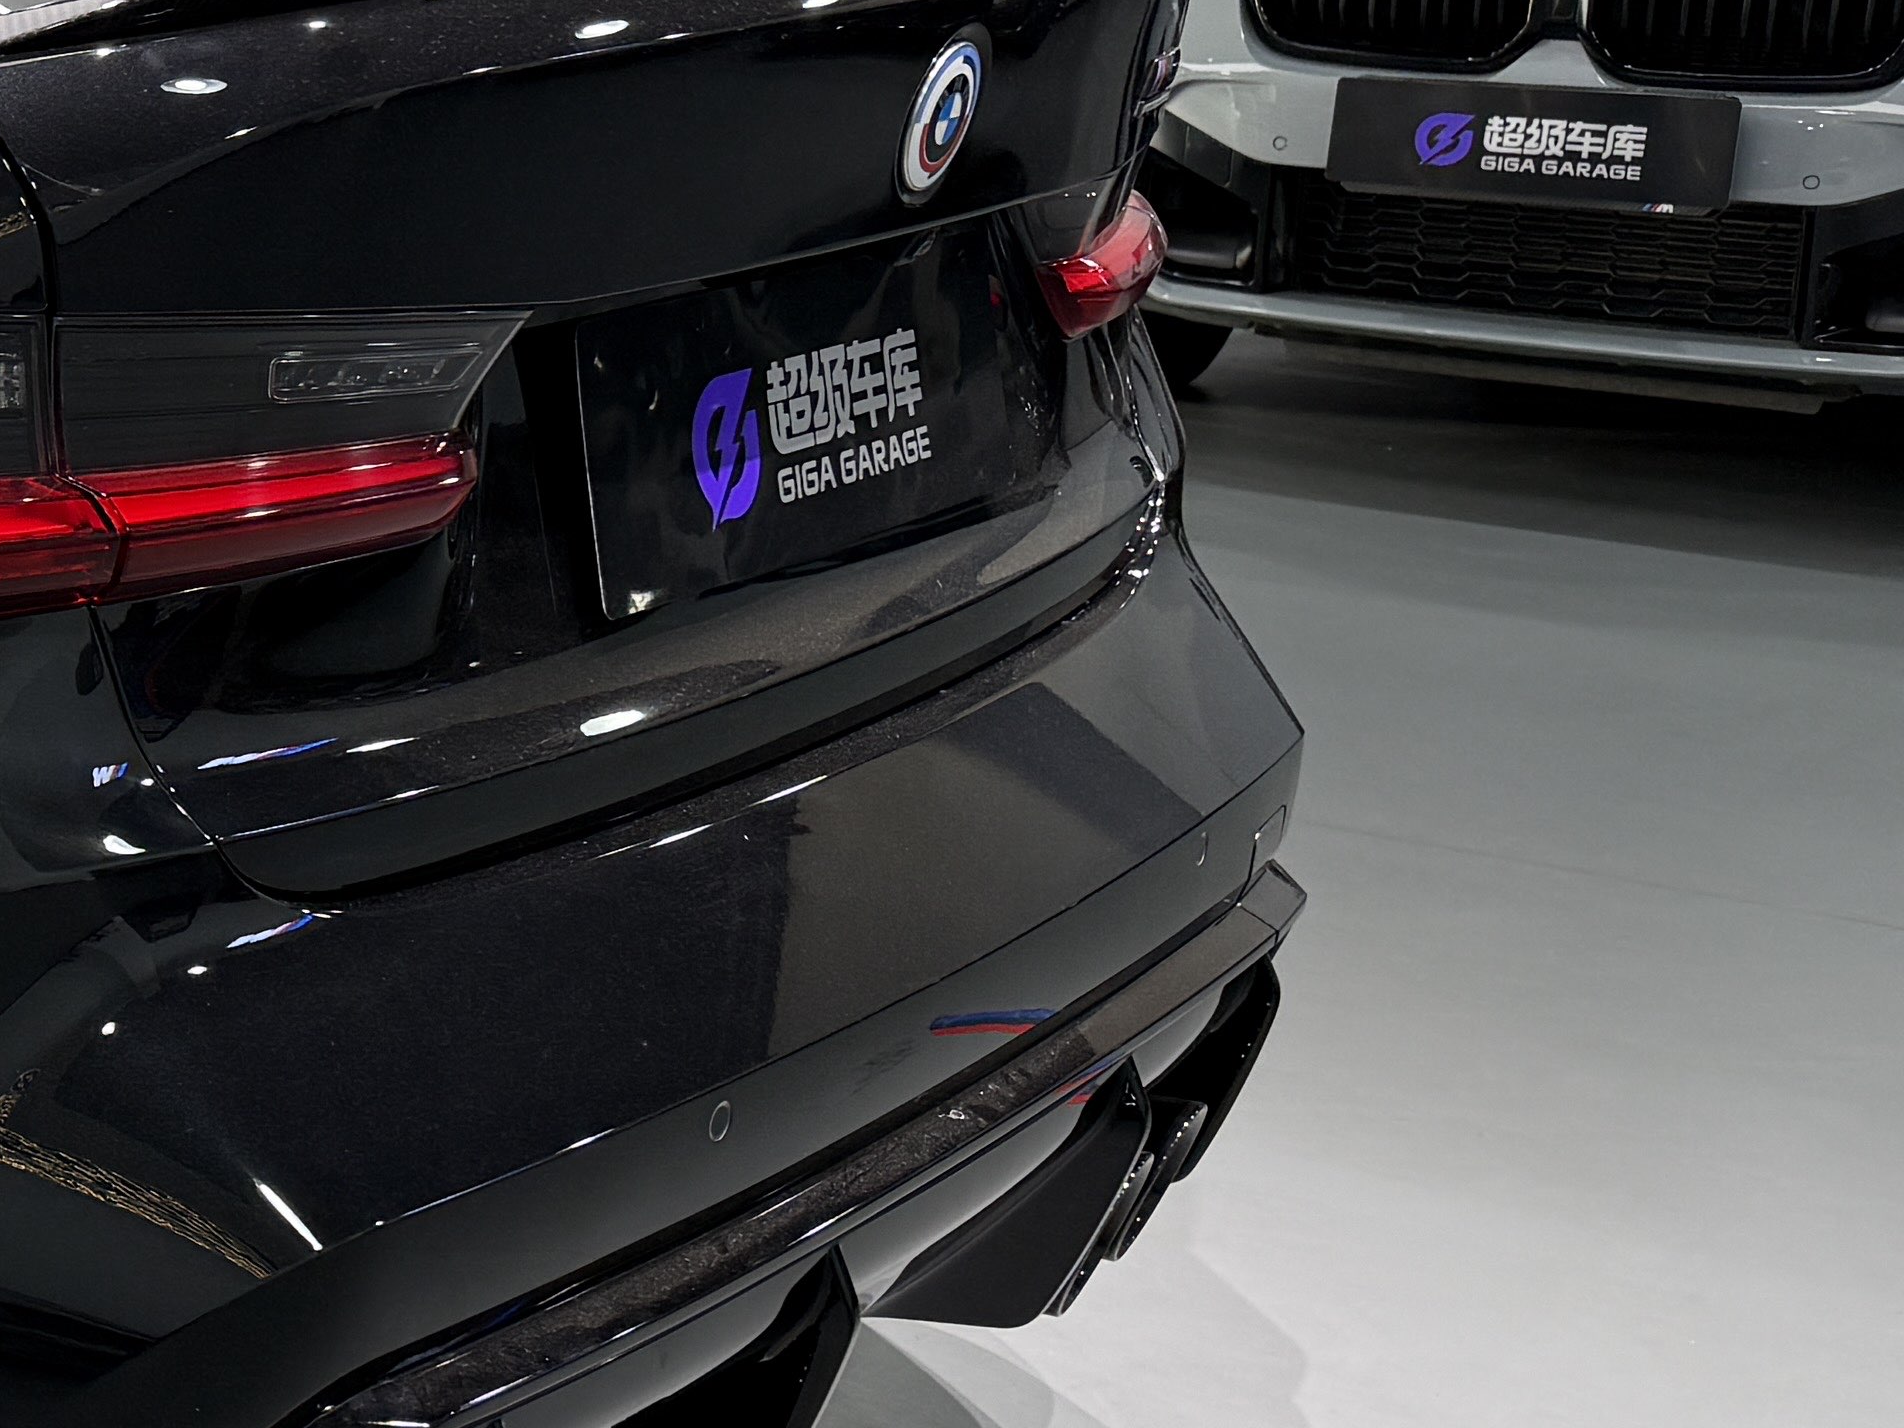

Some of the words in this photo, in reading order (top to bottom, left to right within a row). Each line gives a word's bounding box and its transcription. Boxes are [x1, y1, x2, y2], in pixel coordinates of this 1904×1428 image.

[1480, 155, 1536, 174] GIGA
[1542, 159, 1642, 181] GARAGE
[1483, 116, 1648, 162] 超级车库
[766, 327, 923, 455] 超级车库
[777, 455, 838, 504] GIGA
[839, 425, 932, 485] GARAGE
